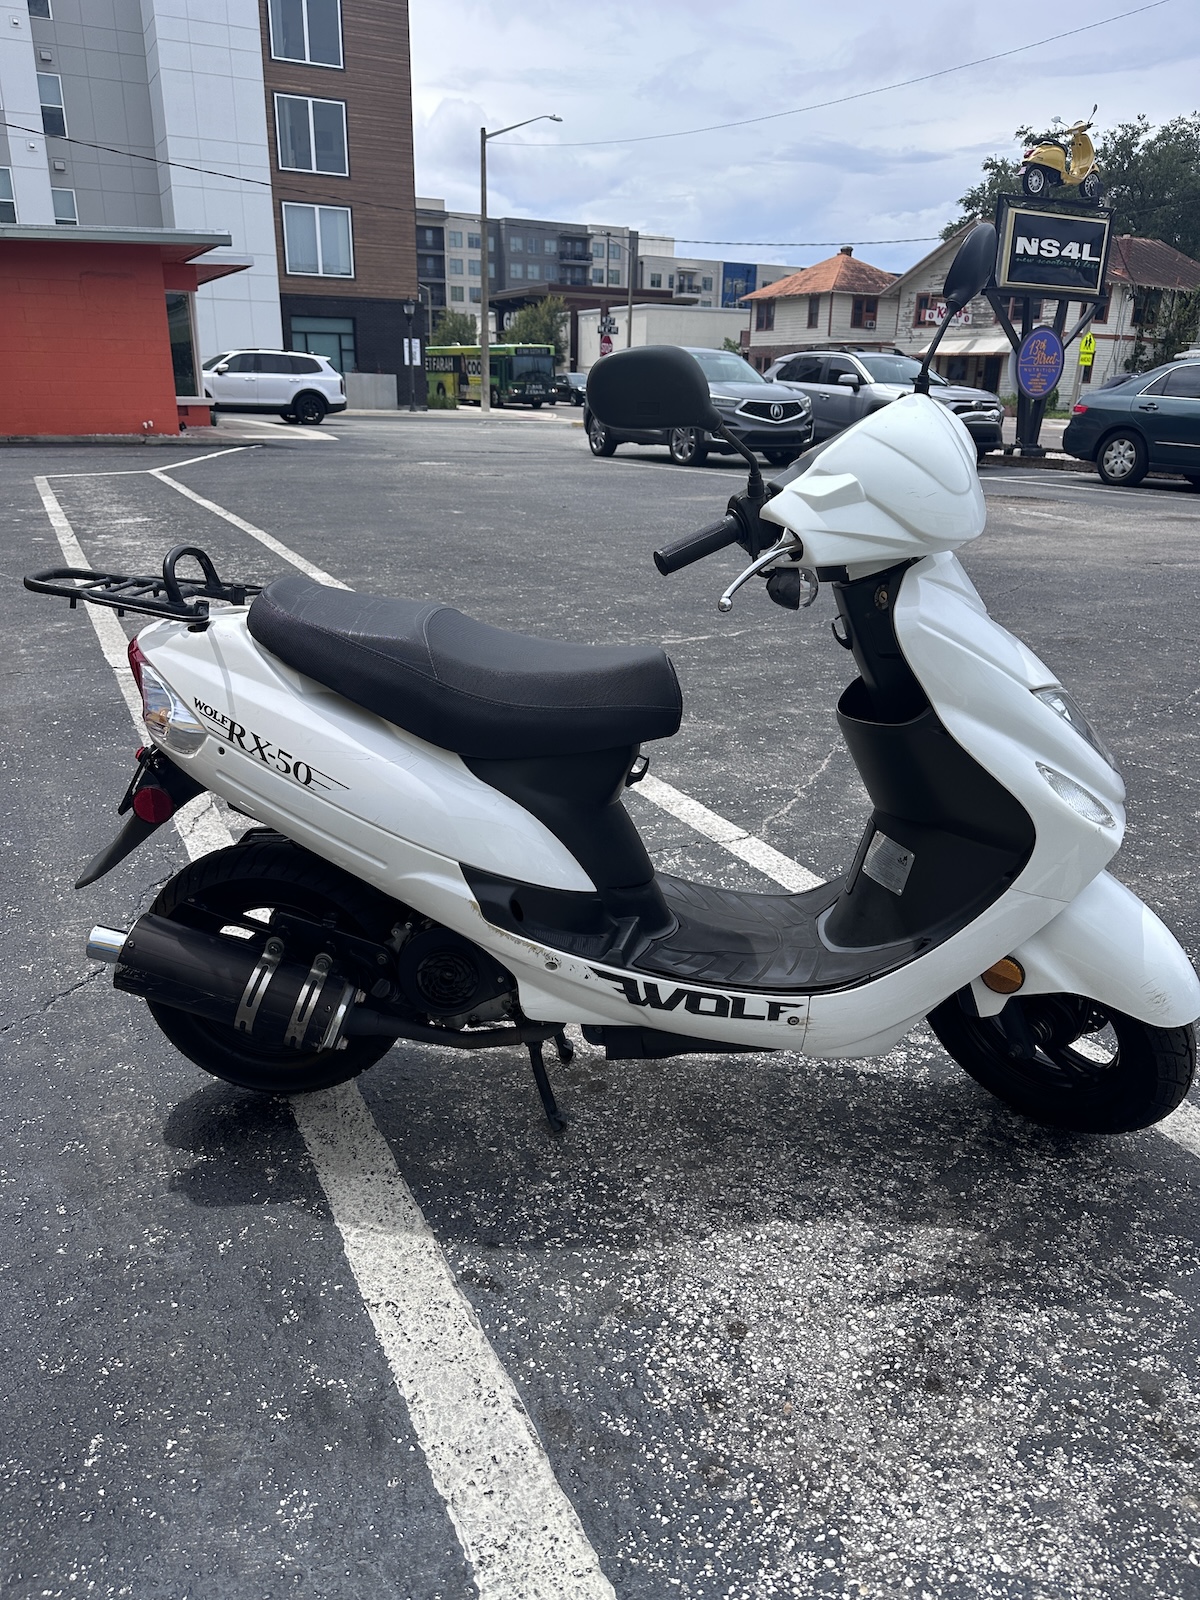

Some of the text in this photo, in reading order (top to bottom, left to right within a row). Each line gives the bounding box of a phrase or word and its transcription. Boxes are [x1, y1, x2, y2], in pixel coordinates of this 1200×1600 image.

[1015, 236, 1101, 262] NS4L
[601, 342, 613, 353] STOP
[1033, 350, 1059, 366] Street
[433, 356, 454, 371] FARAH
[194, 696, 228, 726] WOLF
[226, 717, 313, 787] RX-50
[587, 965, 804, 1021] WOLF
